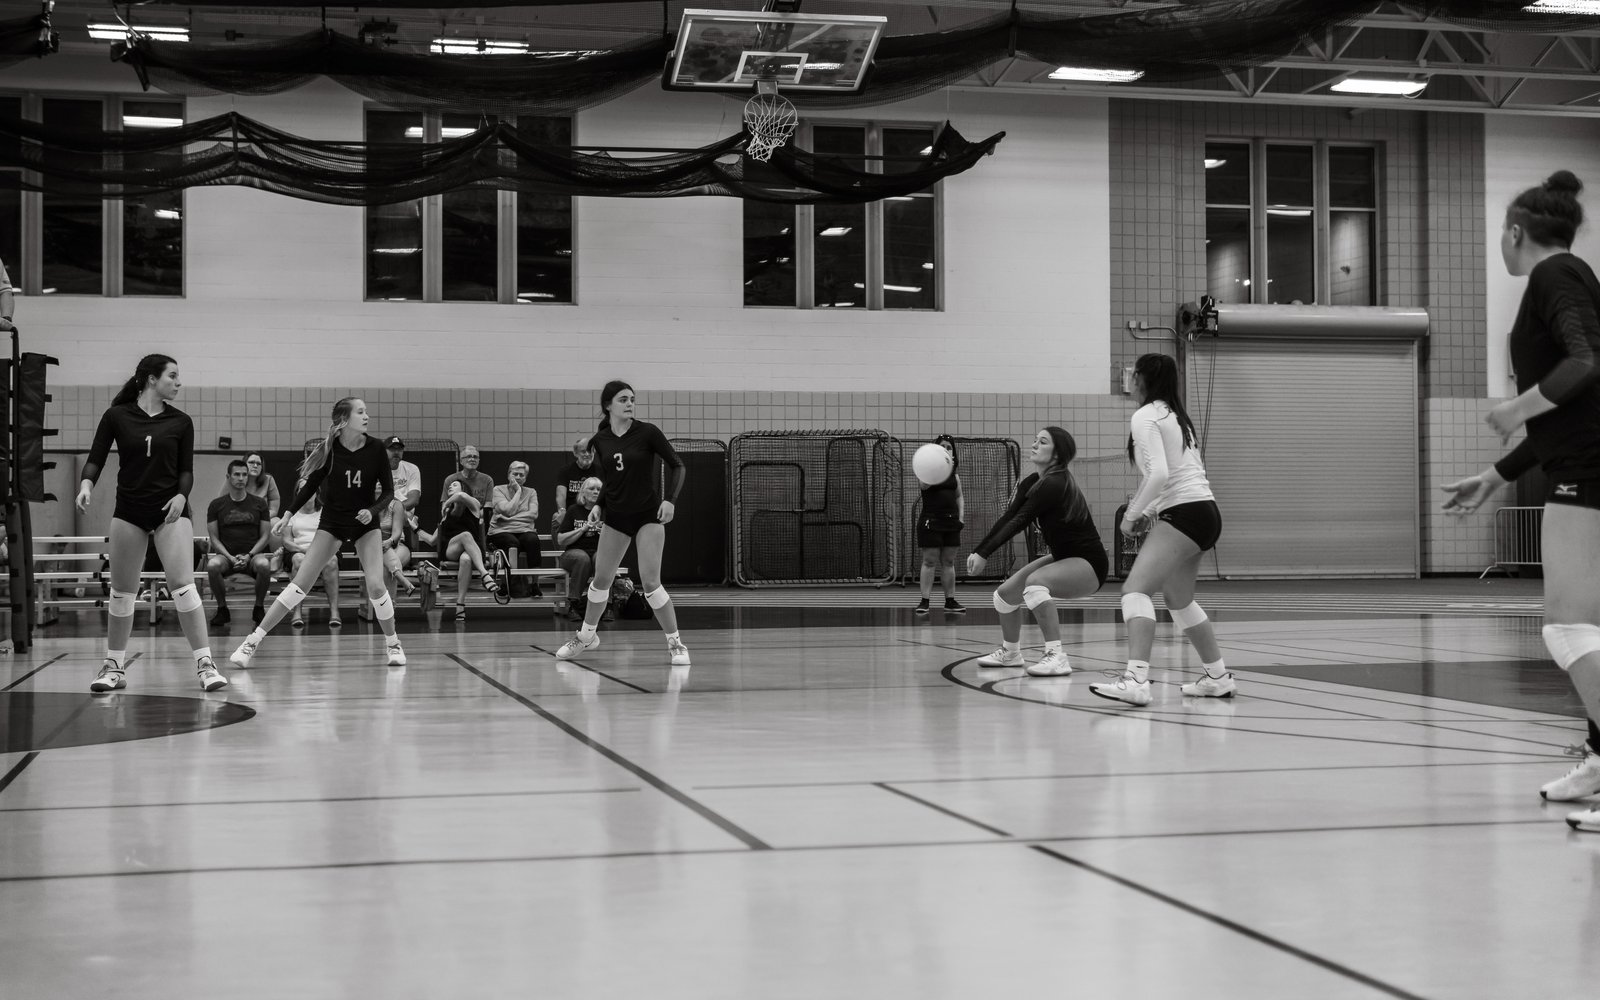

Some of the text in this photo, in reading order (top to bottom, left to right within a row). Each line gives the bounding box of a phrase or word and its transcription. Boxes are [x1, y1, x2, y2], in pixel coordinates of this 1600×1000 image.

[144, 435, 153, 457] 1
[613, 452, 624, 471] 3
[345, 469, 362, 488] 14
